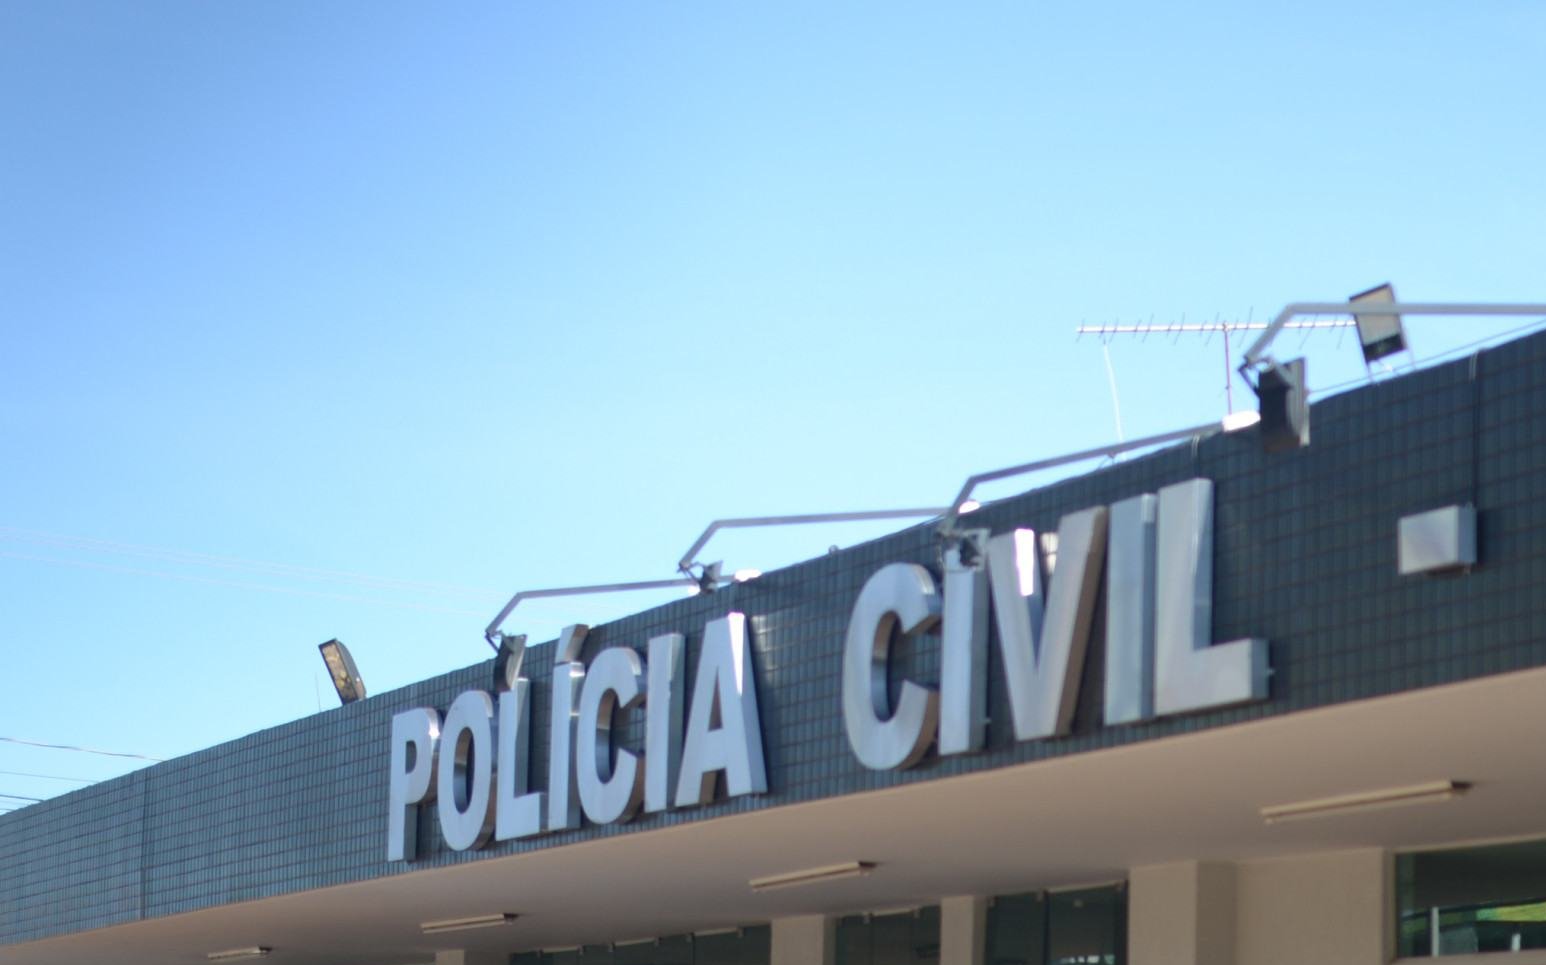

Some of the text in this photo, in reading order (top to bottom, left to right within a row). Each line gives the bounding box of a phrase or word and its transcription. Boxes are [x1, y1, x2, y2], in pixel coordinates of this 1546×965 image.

[387, 612, 768, 862] POLÍCIA
[842, 478, 1268, 770] CIVIL
[1399, 503, 1476, 576] -
